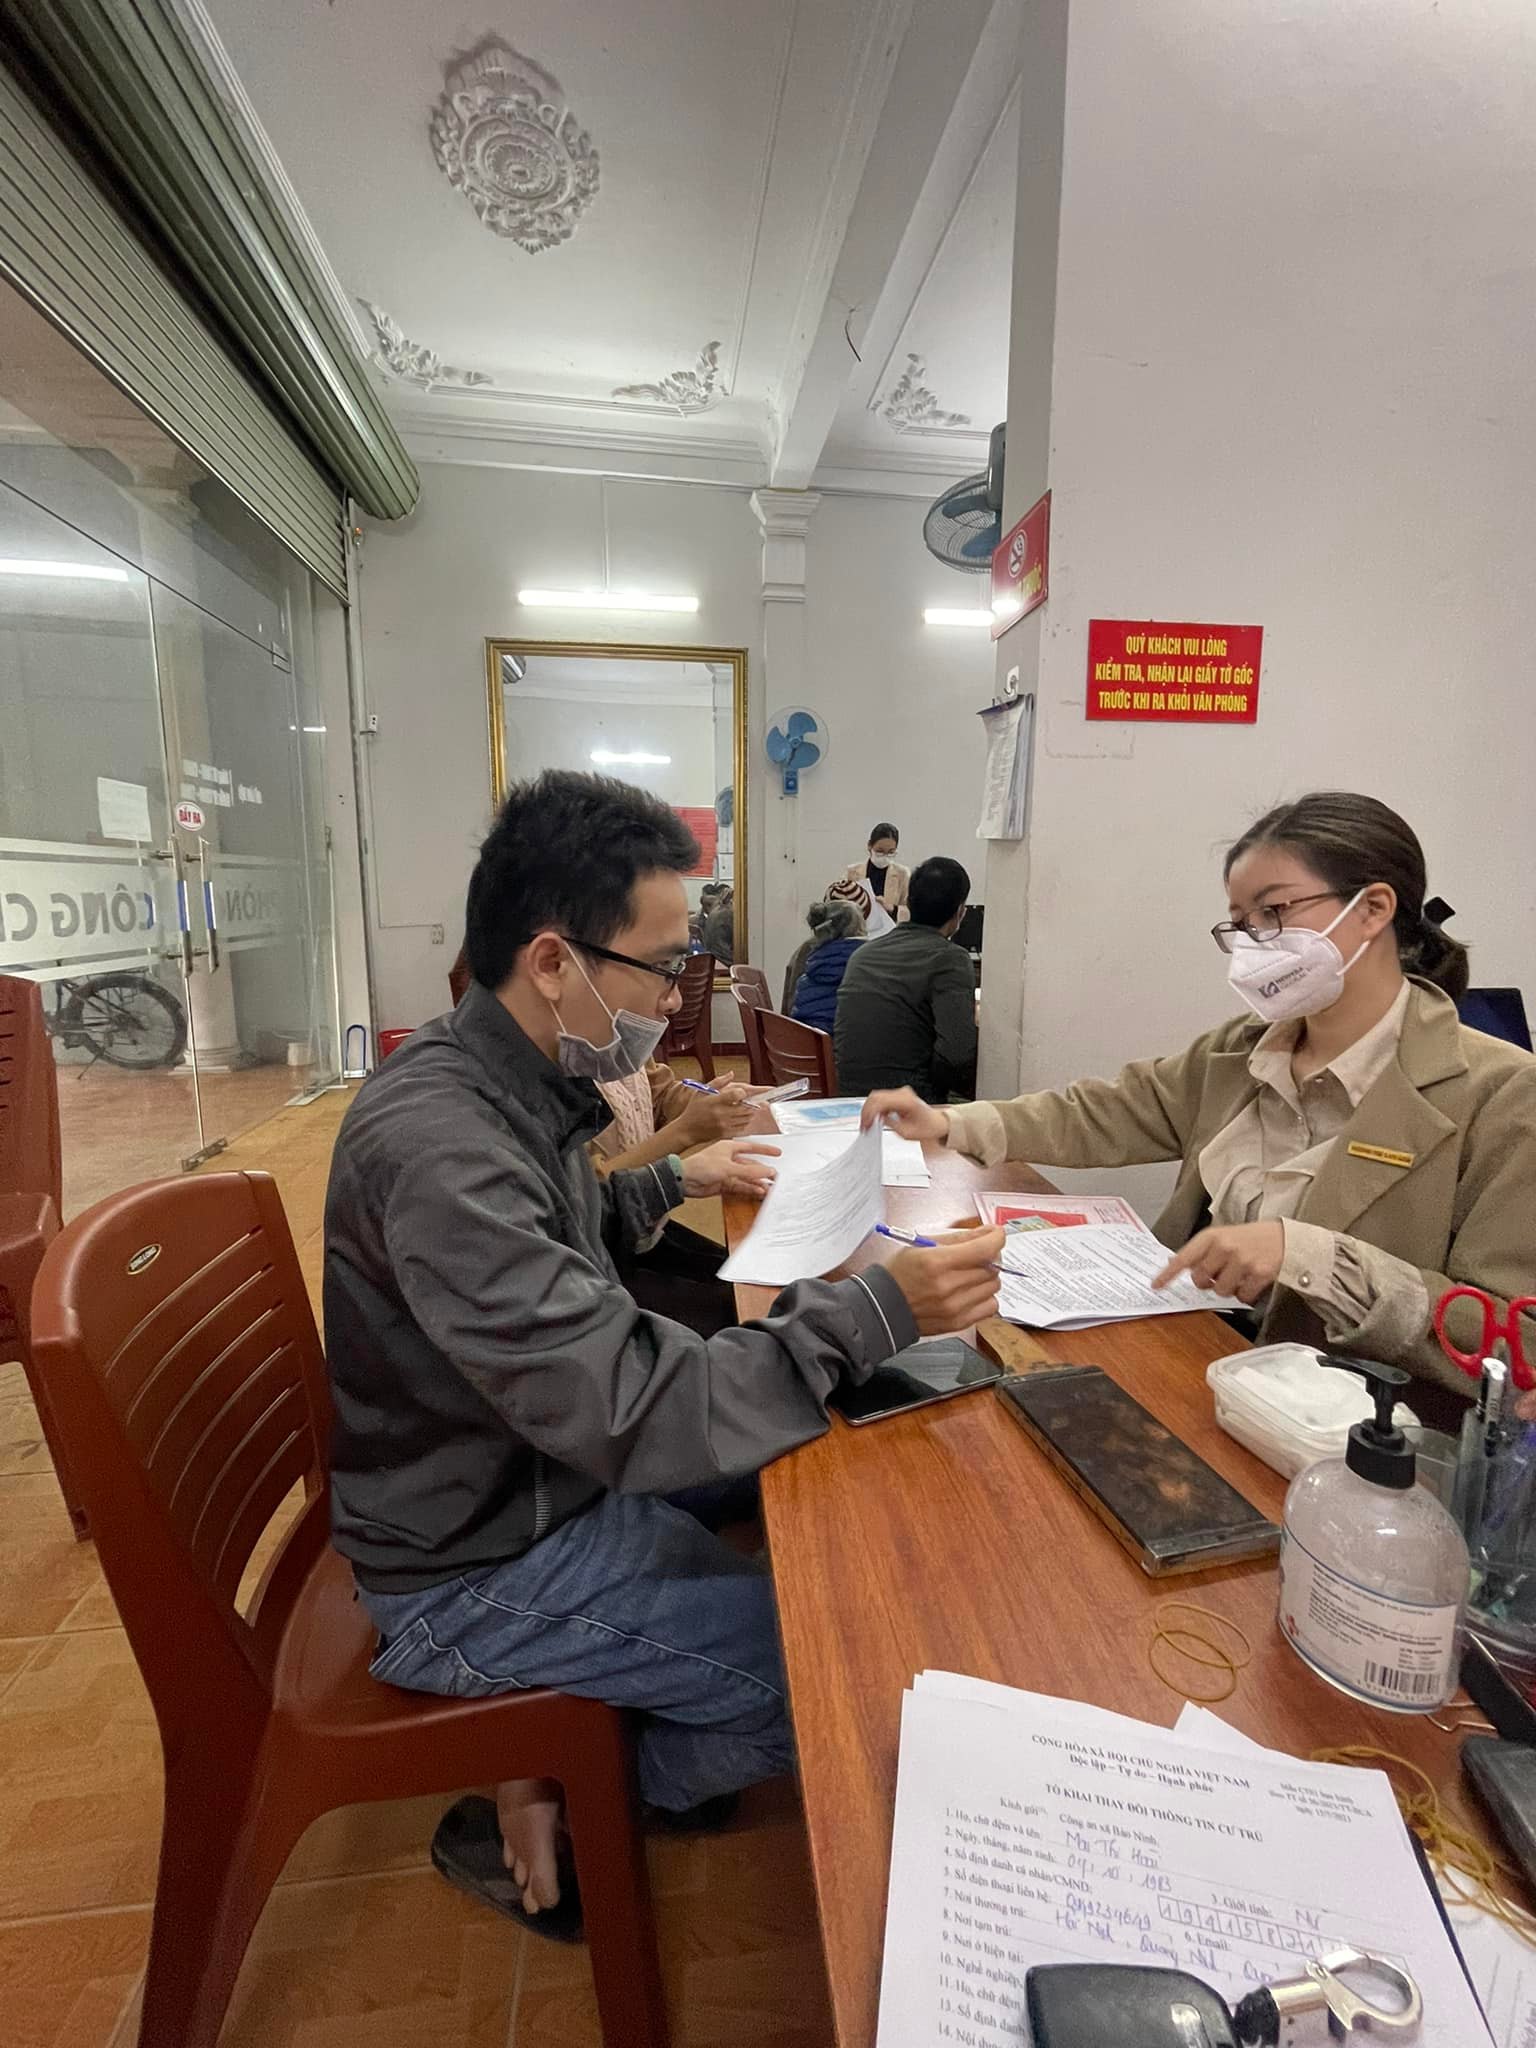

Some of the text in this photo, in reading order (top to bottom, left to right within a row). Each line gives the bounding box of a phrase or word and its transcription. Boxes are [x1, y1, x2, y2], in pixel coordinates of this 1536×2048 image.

[1126, 632, 1228, 657] QUÝ KHÁCH VUI LÒNG
[1095, 656, 1254, 687] KIỂM TRA, NHẬN LẠI GIẤY TỜ GỐC
[1098, 688, 1248, 712] TRƯỚC KHI RA KHỎI VĂN PHÒNG
[1194, 1768, 1220, 1783] VIỆT
[1222, 1775, 1250, 1789] NAM
[1063, 1787, 1092, 1803] KHAI
[1095, 1794, 1124, 1811] THAY
[1150, 1806, 1193, 1828] THÔNG
[1195, 1818, 1216, 1832] TIN
